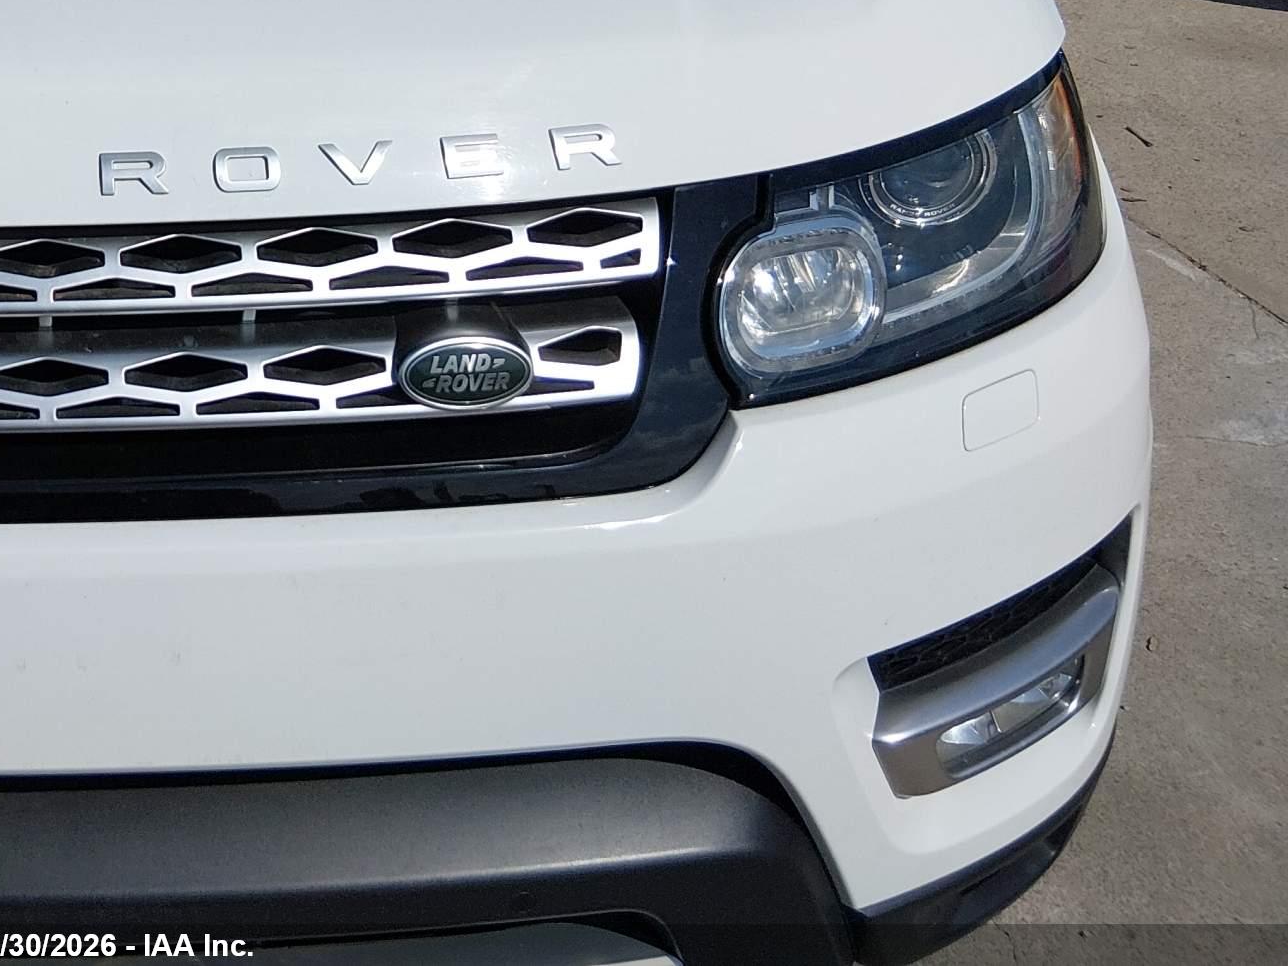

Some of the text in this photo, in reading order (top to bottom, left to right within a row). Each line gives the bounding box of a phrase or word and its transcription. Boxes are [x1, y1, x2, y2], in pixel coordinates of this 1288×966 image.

[98, 124, 622, 196] ROVER
[430, 353, 492, 374] LAND
[435, 372, 511, 393] ROVER
